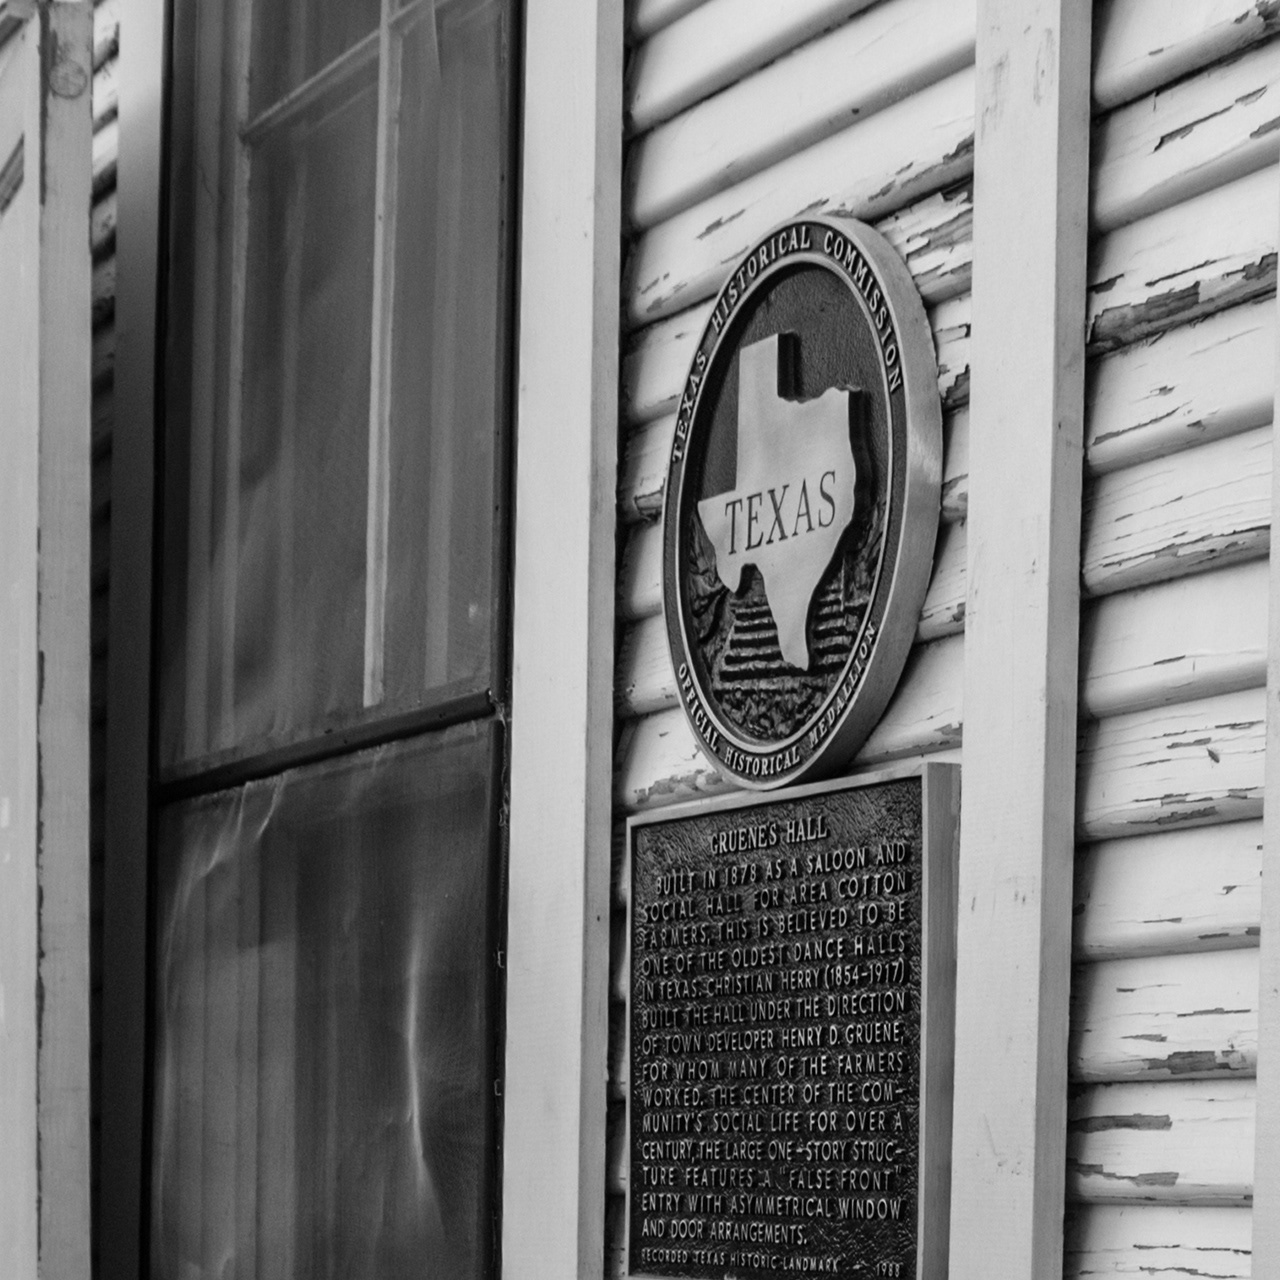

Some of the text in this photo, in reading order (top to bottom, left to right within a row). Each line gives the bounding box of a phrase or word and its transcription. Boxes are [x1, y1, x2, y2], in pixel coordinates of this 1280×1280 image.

[671, 224, 902, 463] TEXAS HISTORICAL COMMISSION
[725, 471, 837, 555] TEXAS
[678, 622, 877, 776] OFFICIAL HISTORICAL MEDALLION
[786, 816, 829, 843] HALL
[656, 843, 906, 895] BUILT IN 1878 AS A SALOON AND
[643, 873, 906, 922] SOCIAL HALL FOR AREA COTTON
[643, 902, 905, 948] FARMERS, THIS IS BELIEVED TO BE
[642, 933, 906, 976] ONE OF THE OLDEST DANCE HALLS
[642, 961, 905, 1001] IN TEXAS. CHRISTIAN HERRY (1854-1917)
[642, 992, 905, 1028] BUILT THE HALL UNDER THE DIRECTION
[642, 1022, 905, 1055] OF TOWN DEVELOPER HENRY D. GRUENE,
[642, 1052, 903, 1081] FOR WHOM MANY OF THE FARMERS
[642, 1087, 703, 1107] WORKED.
[710, 1086, 736, 1105] THE
[743, 1084, 795, 1104] CENTER
[803, 1084, 821, 1103] OF
[828, 1083, 854, 1103] THE
[642, 1111, 903, 1133] MUNITY'S SOCIAL LIFE FOR OVER A
[642, 1141, 694, 1163] CENTURY,
[699, 1141, 720, 1160] THE
[726, 1141, 762, 1160] LARGE
[768, 1142, 846, 1161] ONE-STORY
[642, 1167, 674, 1186] TURE
[685, 1168, 753, 1187] FEATURES
[763, 1170, 772, 1188] A
[642, 1193, 902, 1219] ENTRY WITH ASYMMETRICAL WINDOW
[642, 1218, 807, 1244] AND DOOR ARRANGEMENTS.
[642, 1250, 900, 1277] RECORDED TEXAS HISTORIC LANDMARK 1988
